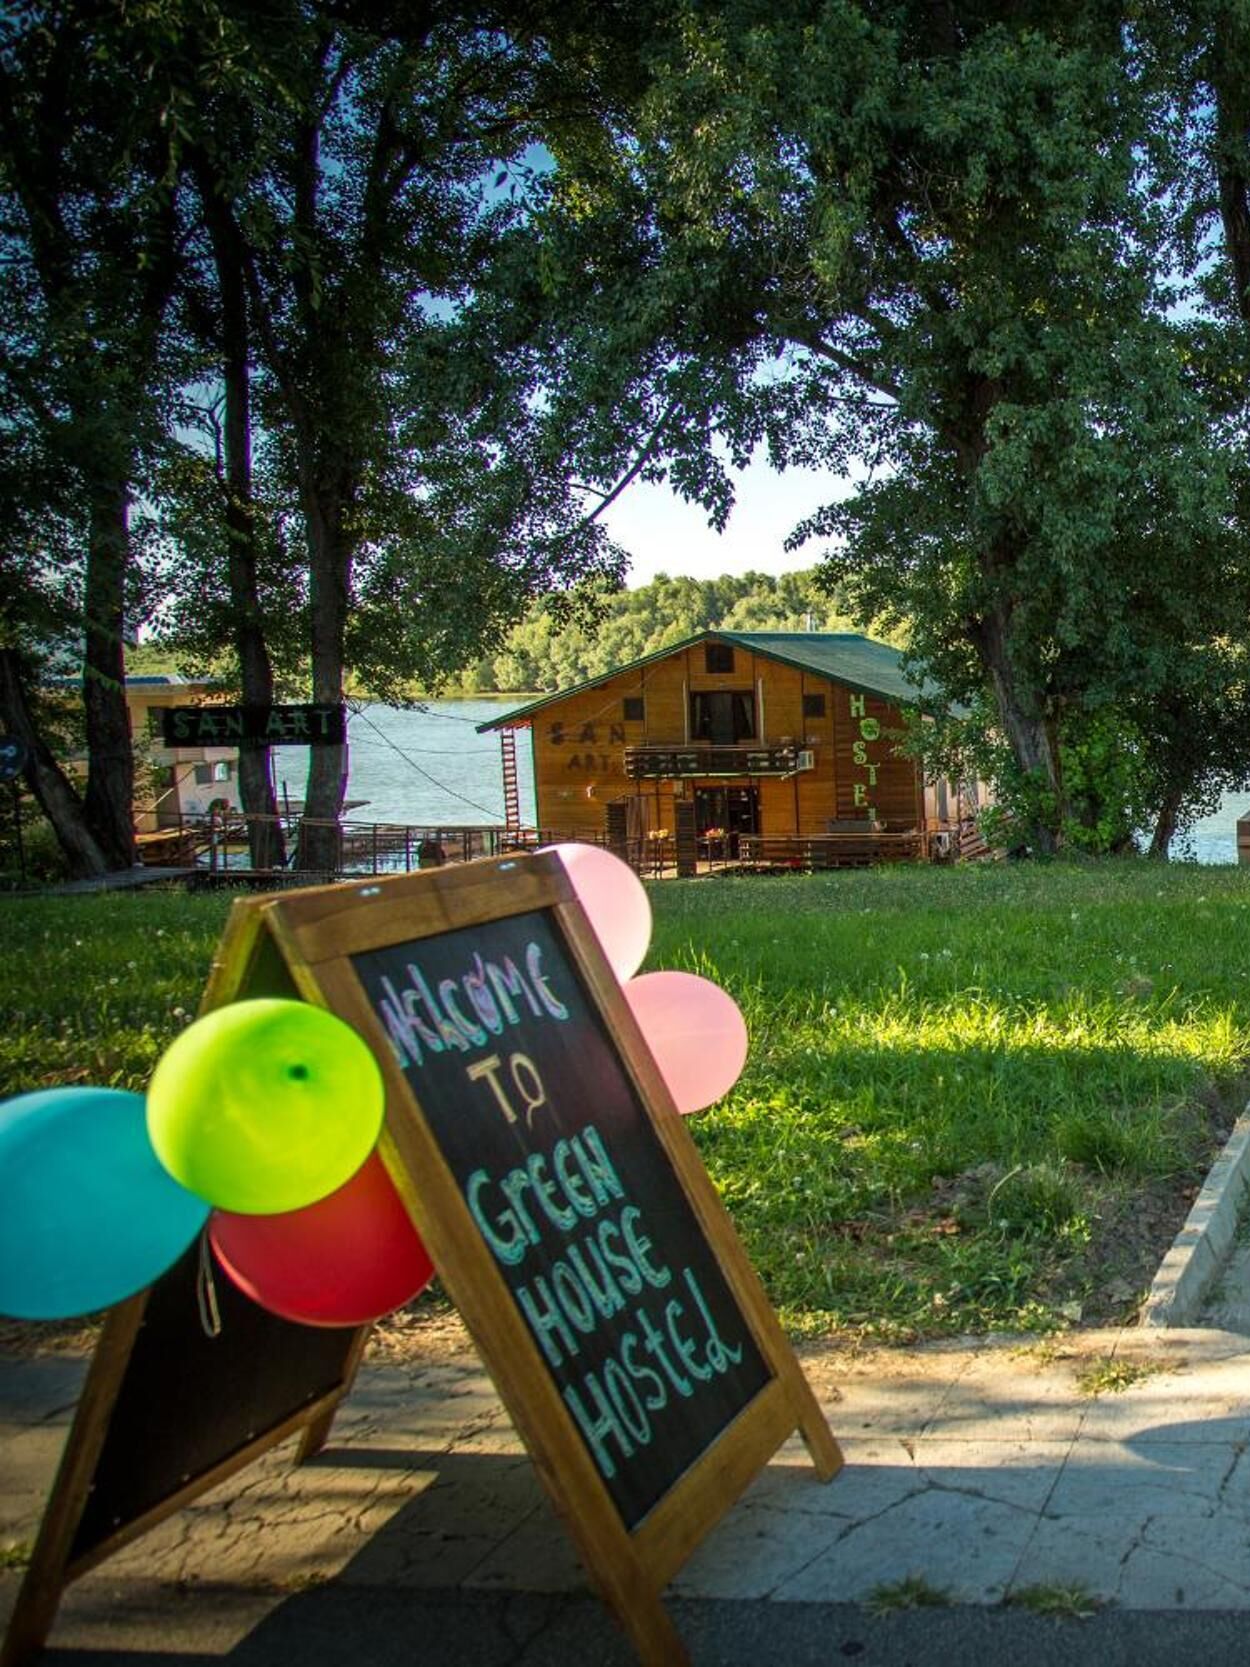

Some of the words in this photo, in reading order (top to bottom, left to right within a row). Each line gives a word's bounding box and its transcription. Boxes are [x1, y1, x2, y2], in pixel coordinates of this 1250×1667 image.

[172, 710, 245, 738] SAN
[265, 710, 333, 735] ART
[466, 1052, 547, 1129] TO
[516, 1205, 672, 1367] HOUSE
